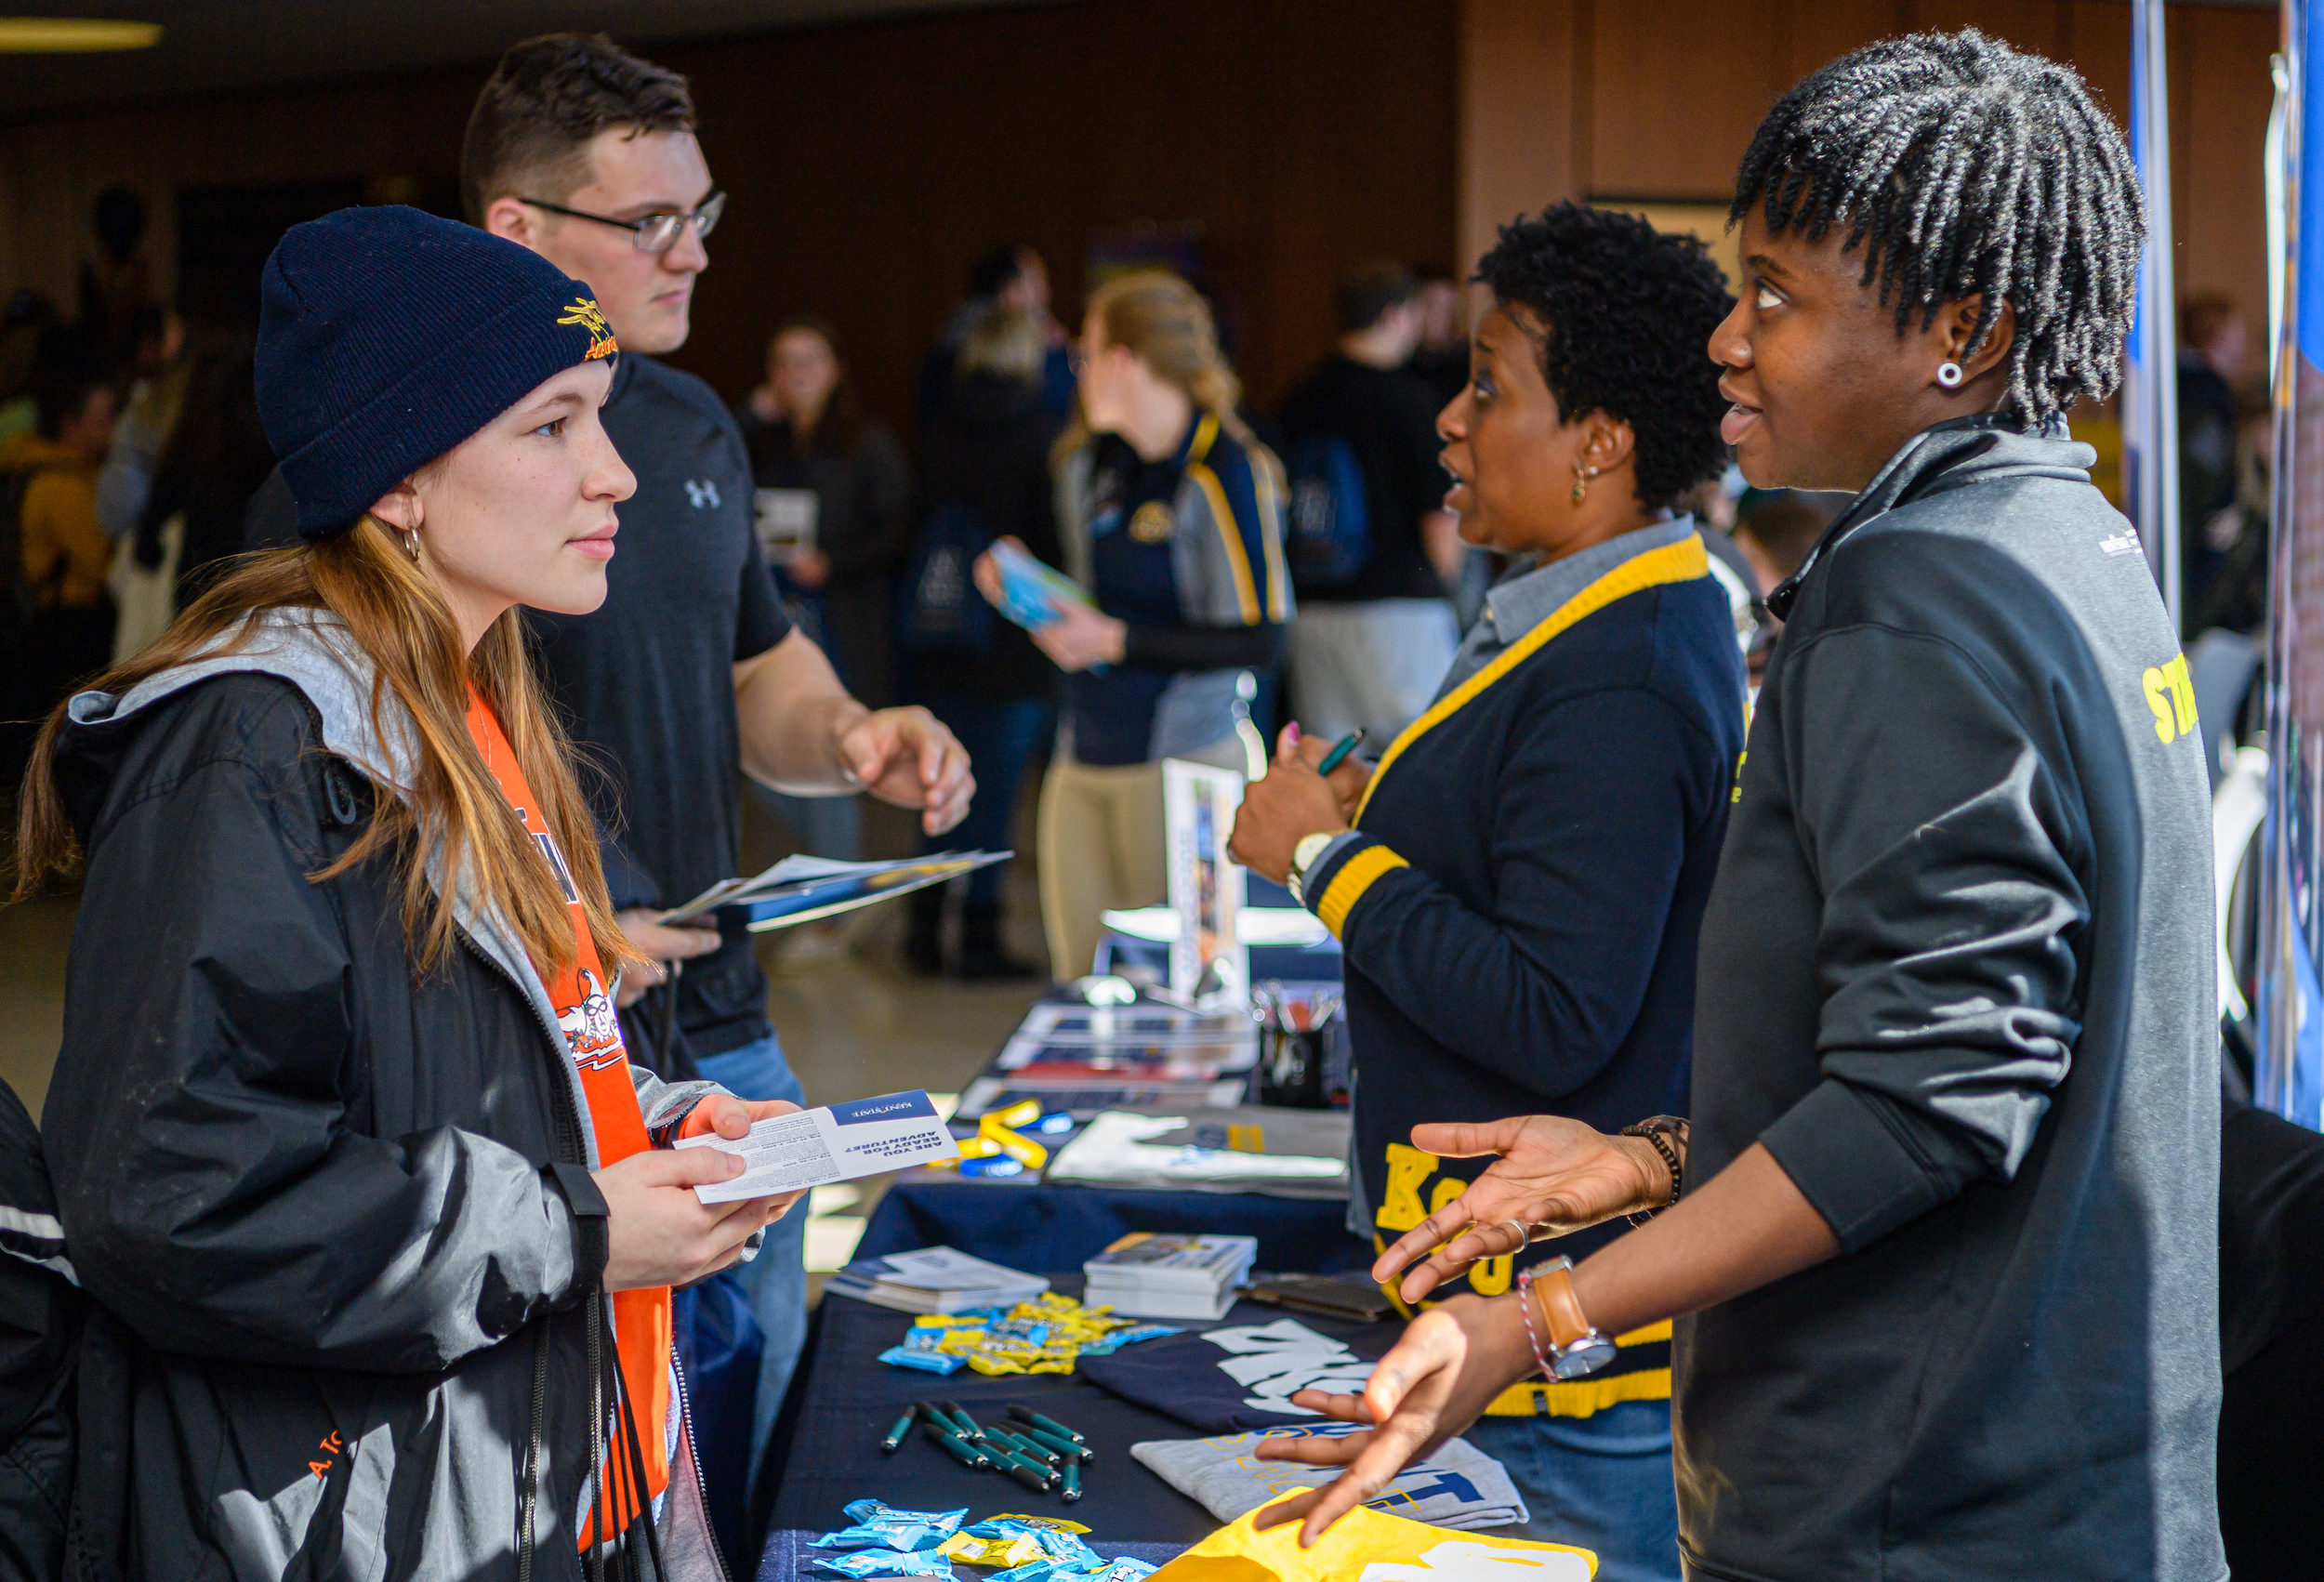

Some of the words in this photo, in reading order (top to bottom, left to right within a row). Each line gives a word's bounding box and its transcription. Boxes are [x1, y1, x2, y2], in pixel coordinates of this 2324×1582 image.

[884, 1101, 912, 1111] KENT
[852, 1107, 882, 1117] STATE
[844, 1130, 936, 1153] ADVENTURE?
[894, 1136, 941, 1149] READY
[917, 1141, 943, 1150] ARE
[884, 1148, 912, 1156] YOU
[308, 1459, 333, 1480] A.
